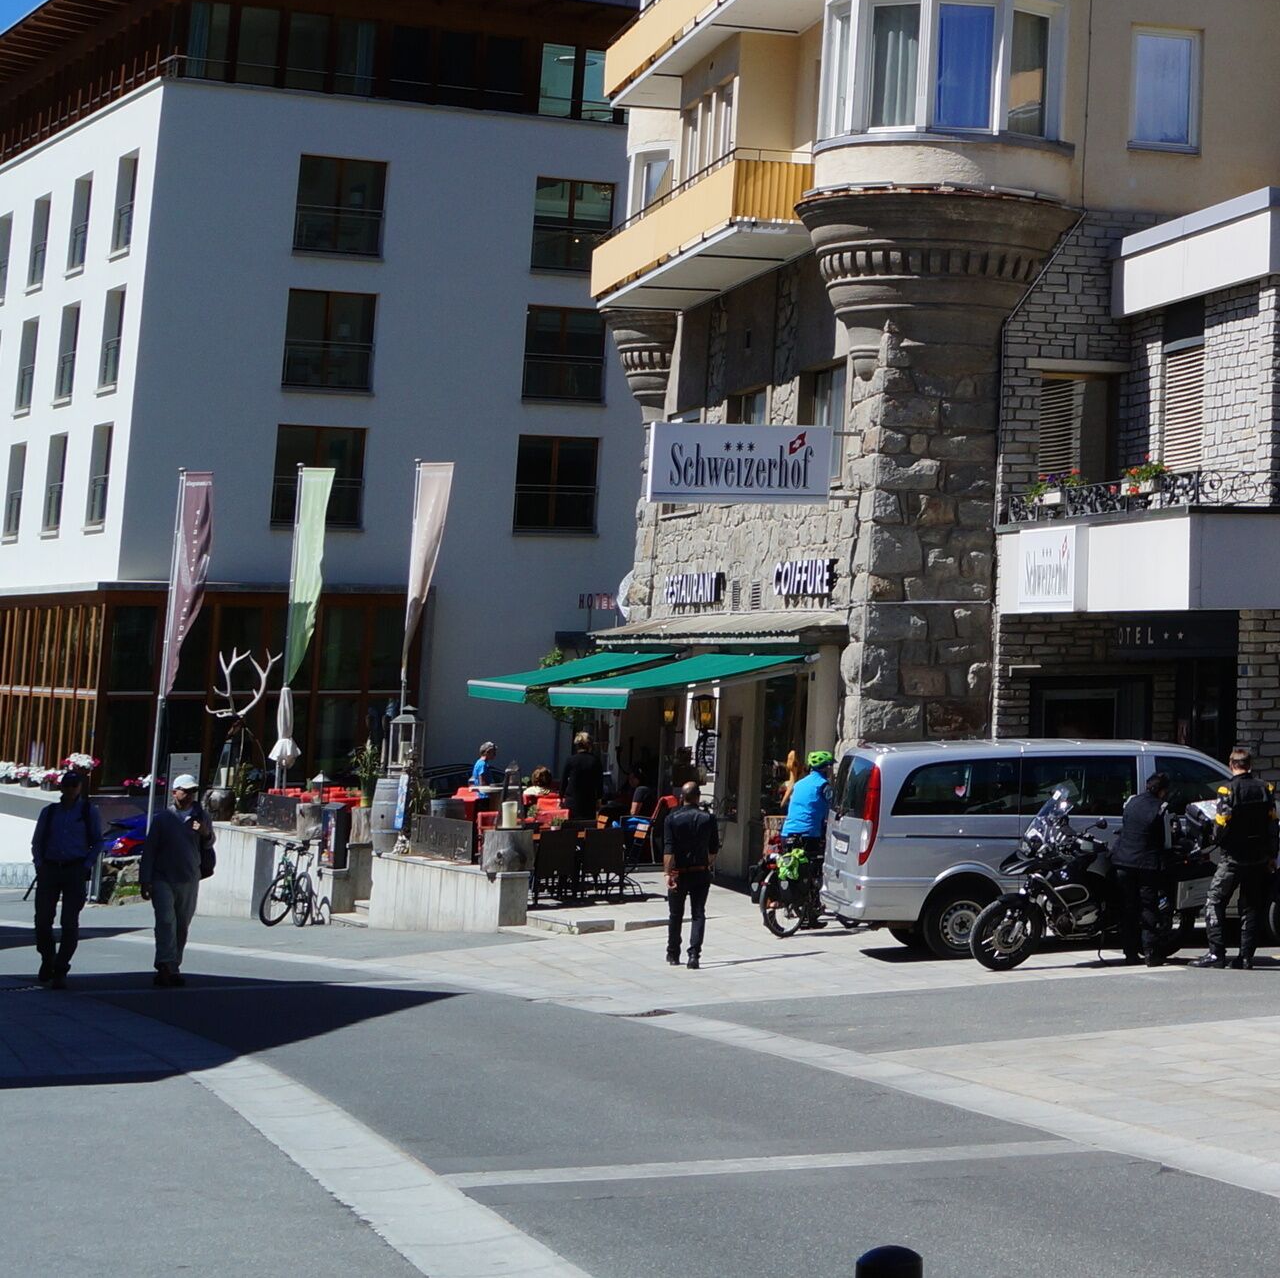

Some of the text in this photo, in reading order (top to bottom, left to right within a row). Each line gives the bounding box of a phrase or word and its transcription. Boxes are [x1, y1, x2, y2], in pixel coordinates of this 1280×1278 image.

[669, 442, 814, 490] Schweizerhof
[663, 573, 717, 604] RESTAURANT
[773, 559, 830, 596] COIFFURE
[579, 593, 616, 610] HOTEL
